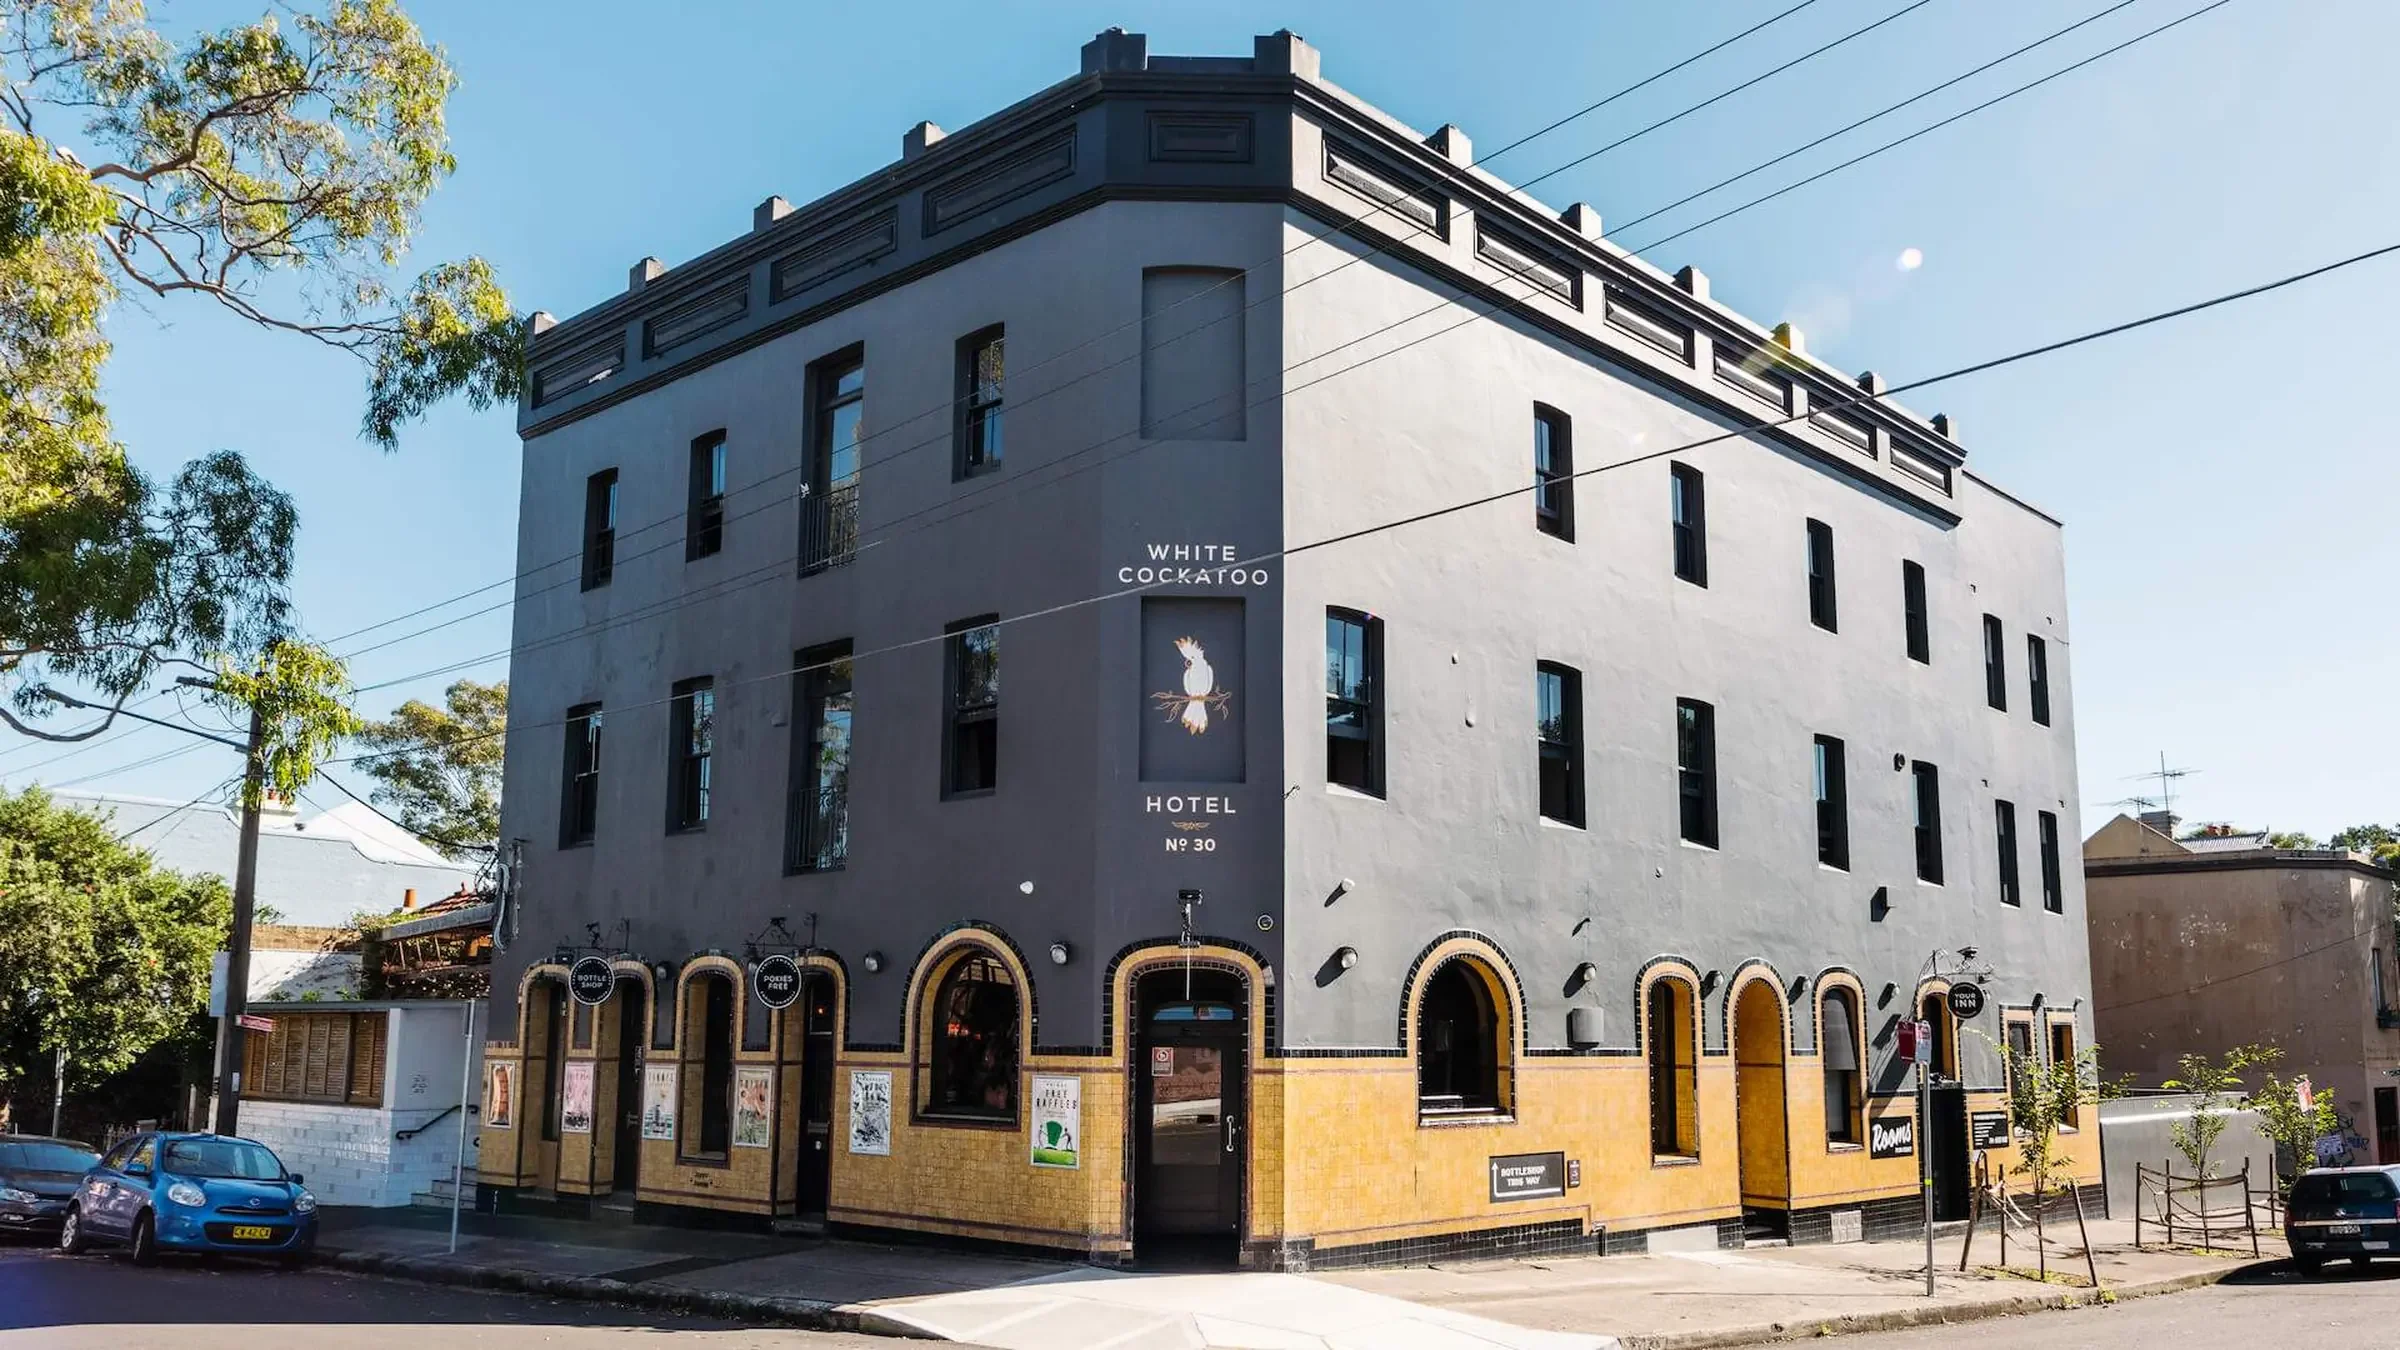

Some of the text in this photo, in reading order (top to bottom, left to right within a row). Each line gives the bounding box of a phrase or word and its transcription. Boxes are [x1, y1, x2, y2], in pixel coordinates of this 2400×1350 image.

[1147, 543, 1236, 561] WHITE
[1118, 566, 1269, 586] COCKATOO
[1146, 795, 1237, 814] HOTEL
[1193, 837, 1216, 852] 30
[577, 974, 607, 982] BOTTLE
[763, 975, 793, 983] POKIES
[581, 981, 603, 989] SHOP
[767, 982, 789, 990] FREE
[1954, 999, 1977, 1008] INN
[1036, 1098, 1077, 1110] RAFFLES
[1872, 1122, 1912, 1153] Rooms
[1500, 1165, 1546, 1177] BOTTLESHOP
[1507, 1176, 1541, 1187] THIS WAY
